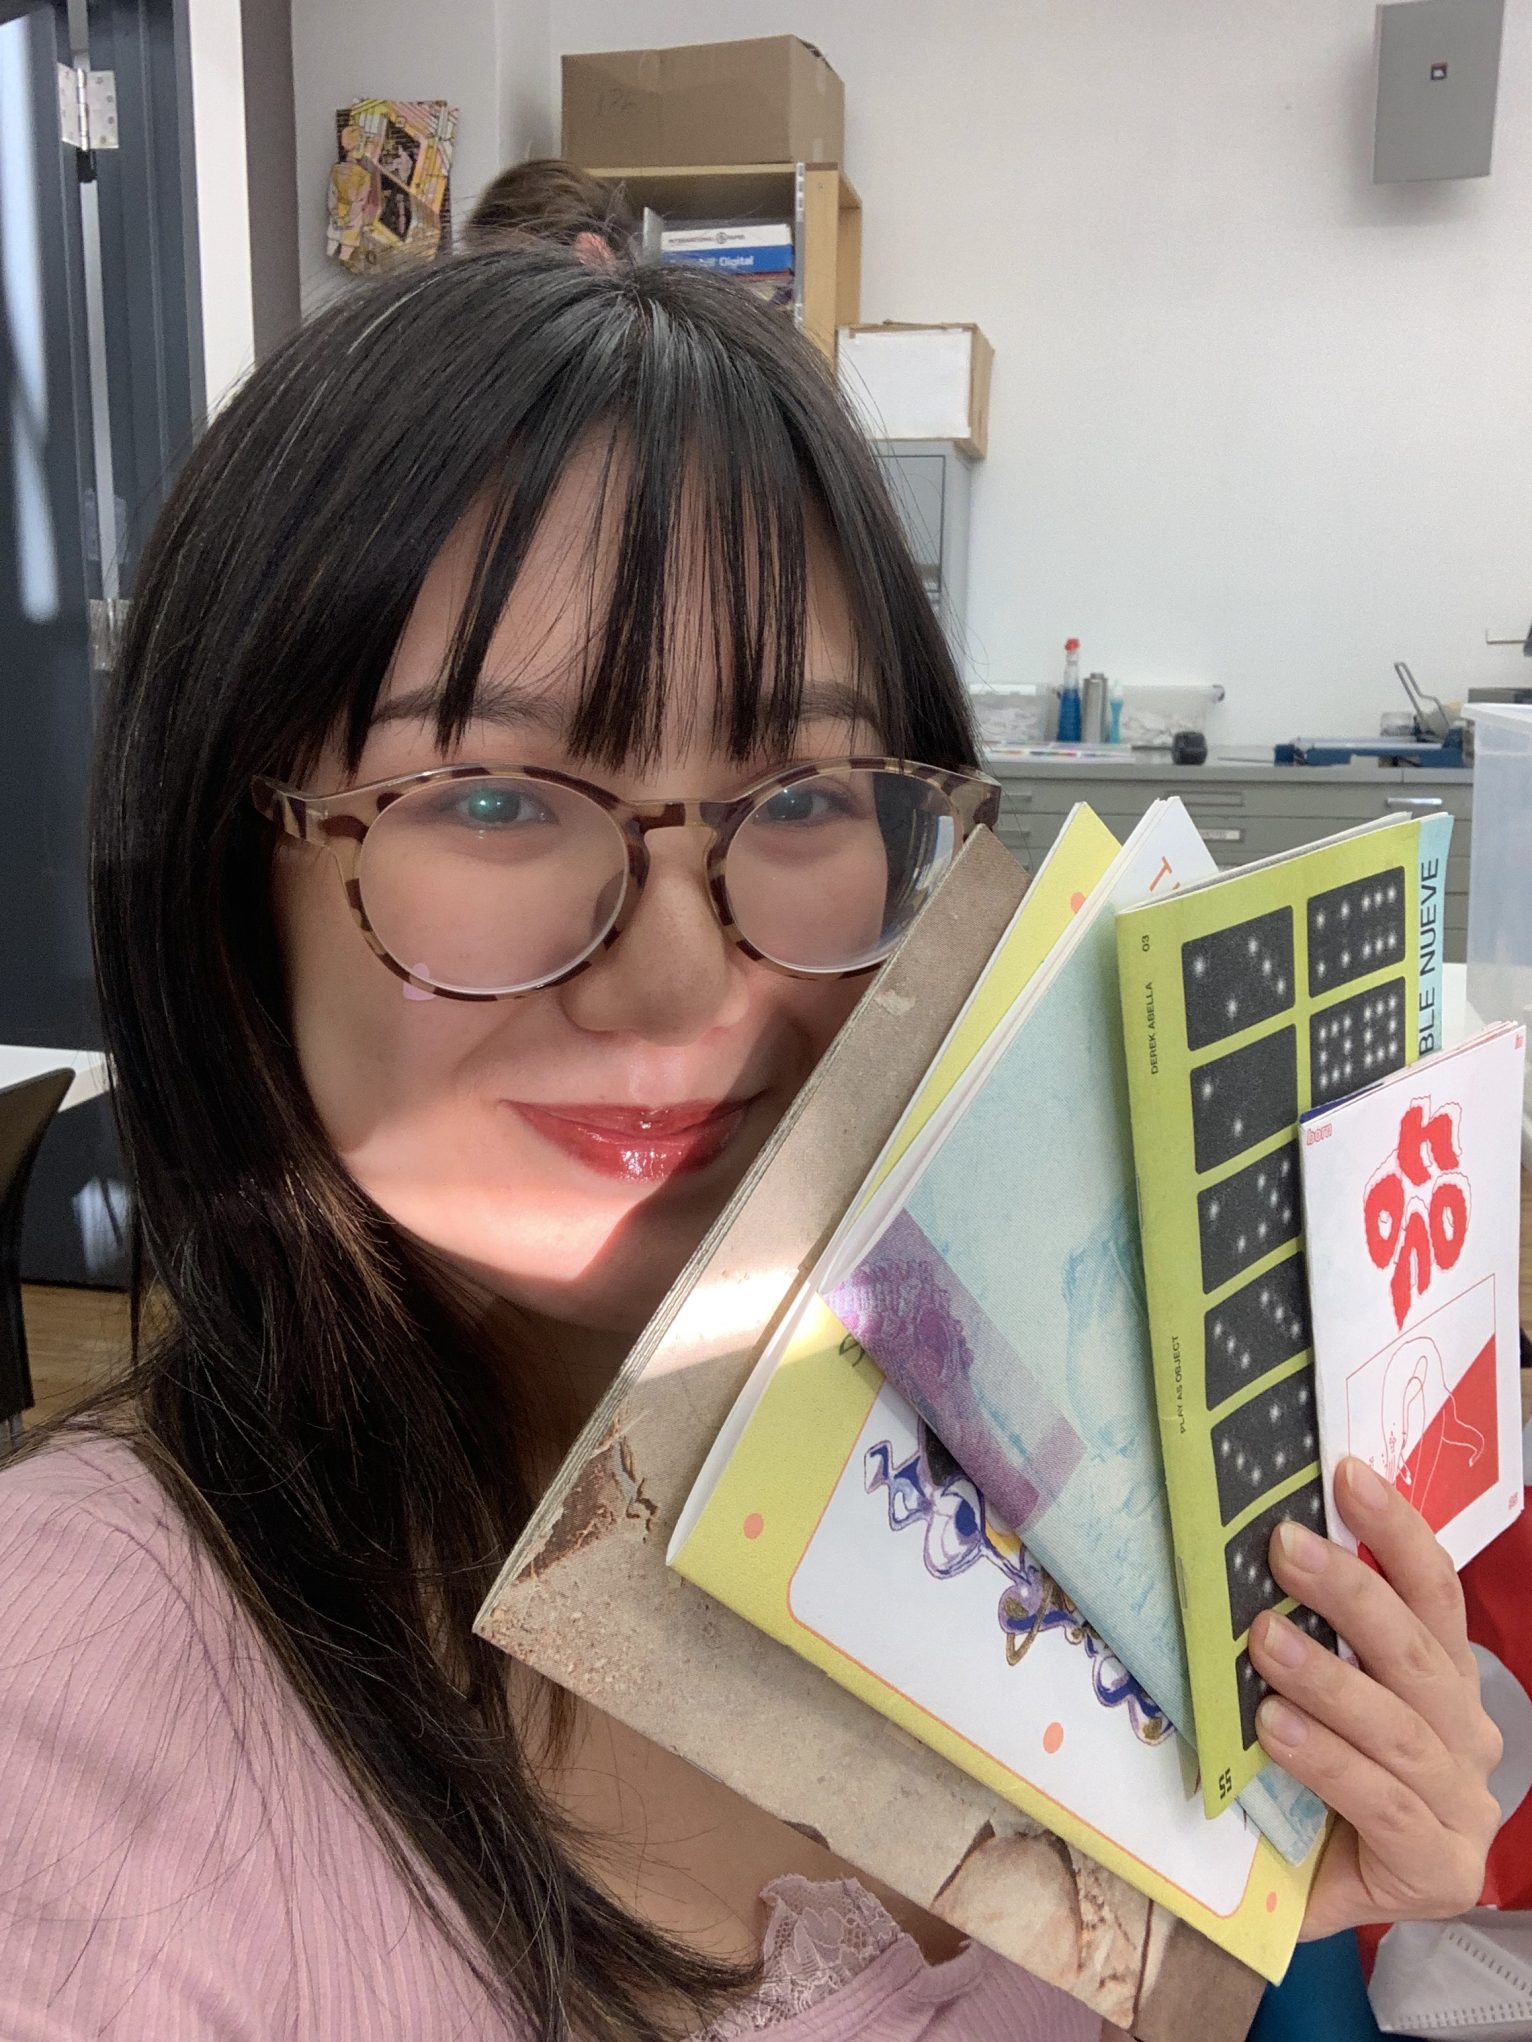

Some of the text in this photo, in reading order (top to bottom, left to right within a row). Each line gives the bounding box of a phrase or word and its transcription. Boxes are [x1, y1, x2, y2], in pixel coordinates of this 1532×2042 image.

[719, 255, 754, 268] Digital
[1141, 934, 1151, 953] 03
[1419, 858, 1439, 977] NUEVE
[1144, 981, 1159, 1075] DEREK ABELLA
[1171, 1335, 1187, 1434] PLAY AS OBJECT
